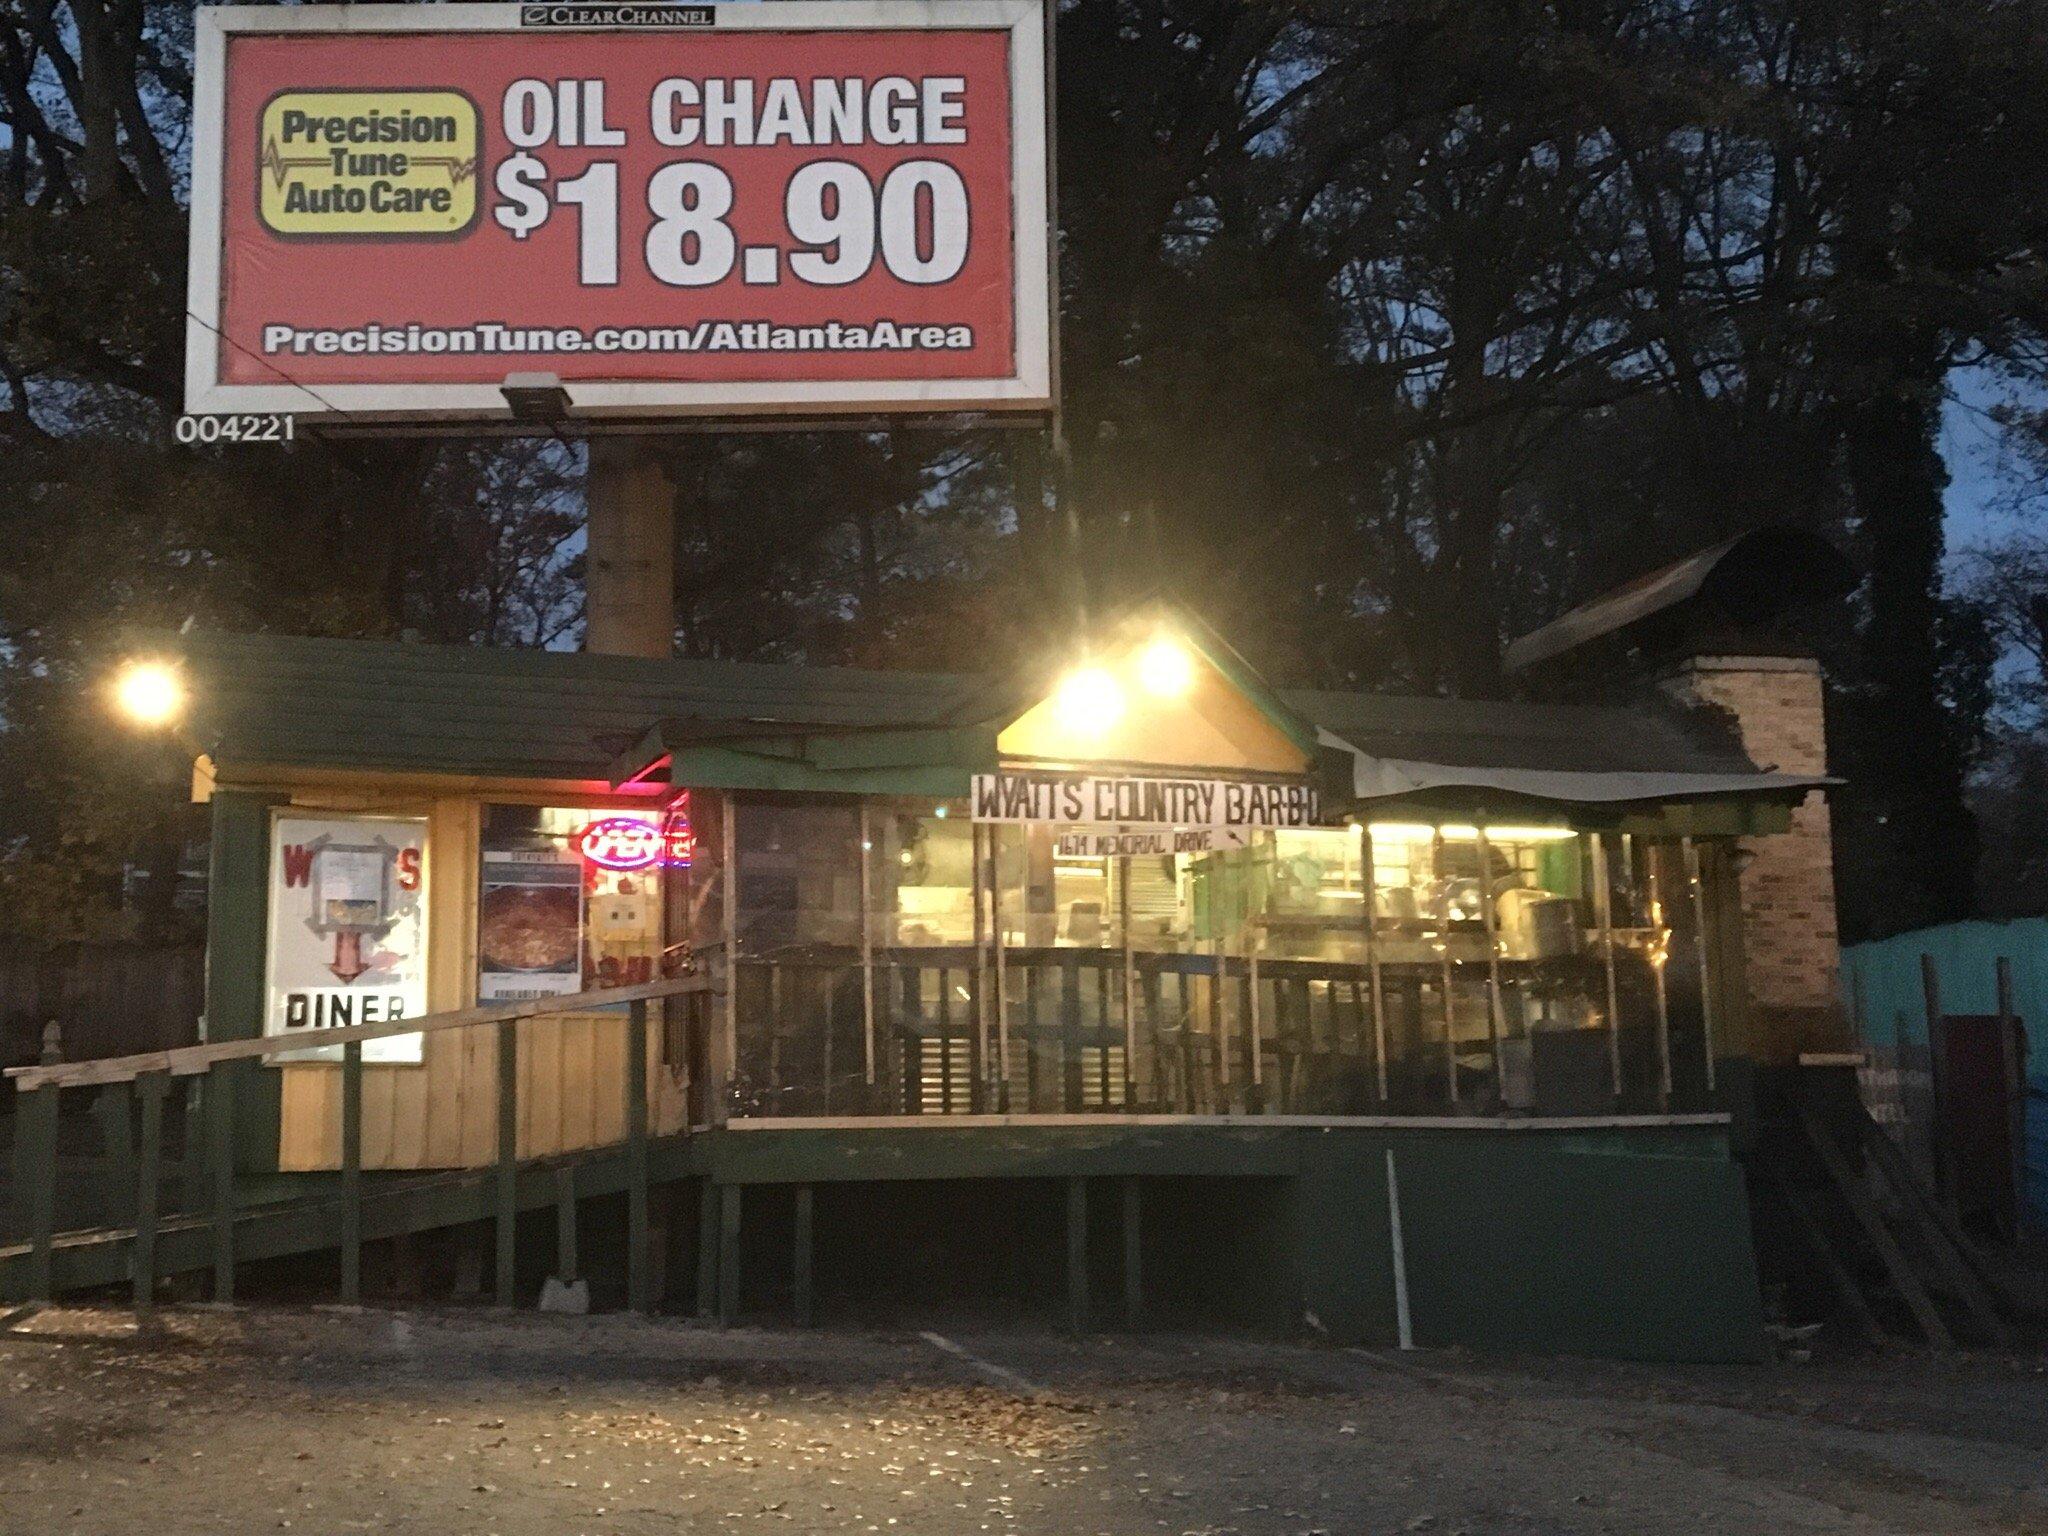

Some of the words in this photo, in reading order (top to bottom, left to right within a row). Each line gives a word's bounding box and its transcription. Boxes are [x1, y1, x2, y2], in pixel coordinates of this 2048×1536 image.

[282, 109, 456, 143] Precision
[503, 79, 626, 147] OIL
[651, 77, 967, 147] CHANGE
[330, 148, 408, 176] Tune
[495, 151, 969, 285] $18.90
[264, 322, 972, 354] PrecisionTune.com/AtlantaArea
[176, 415, 294, 442] 004221
[1094, 780, 1215, 824] COUNTRY
[1096, 834, 1166, 856] MEMORIAL
[1174, 830, 1213, 853] DRIVE
[286, 993, 405, 1028] DINER
